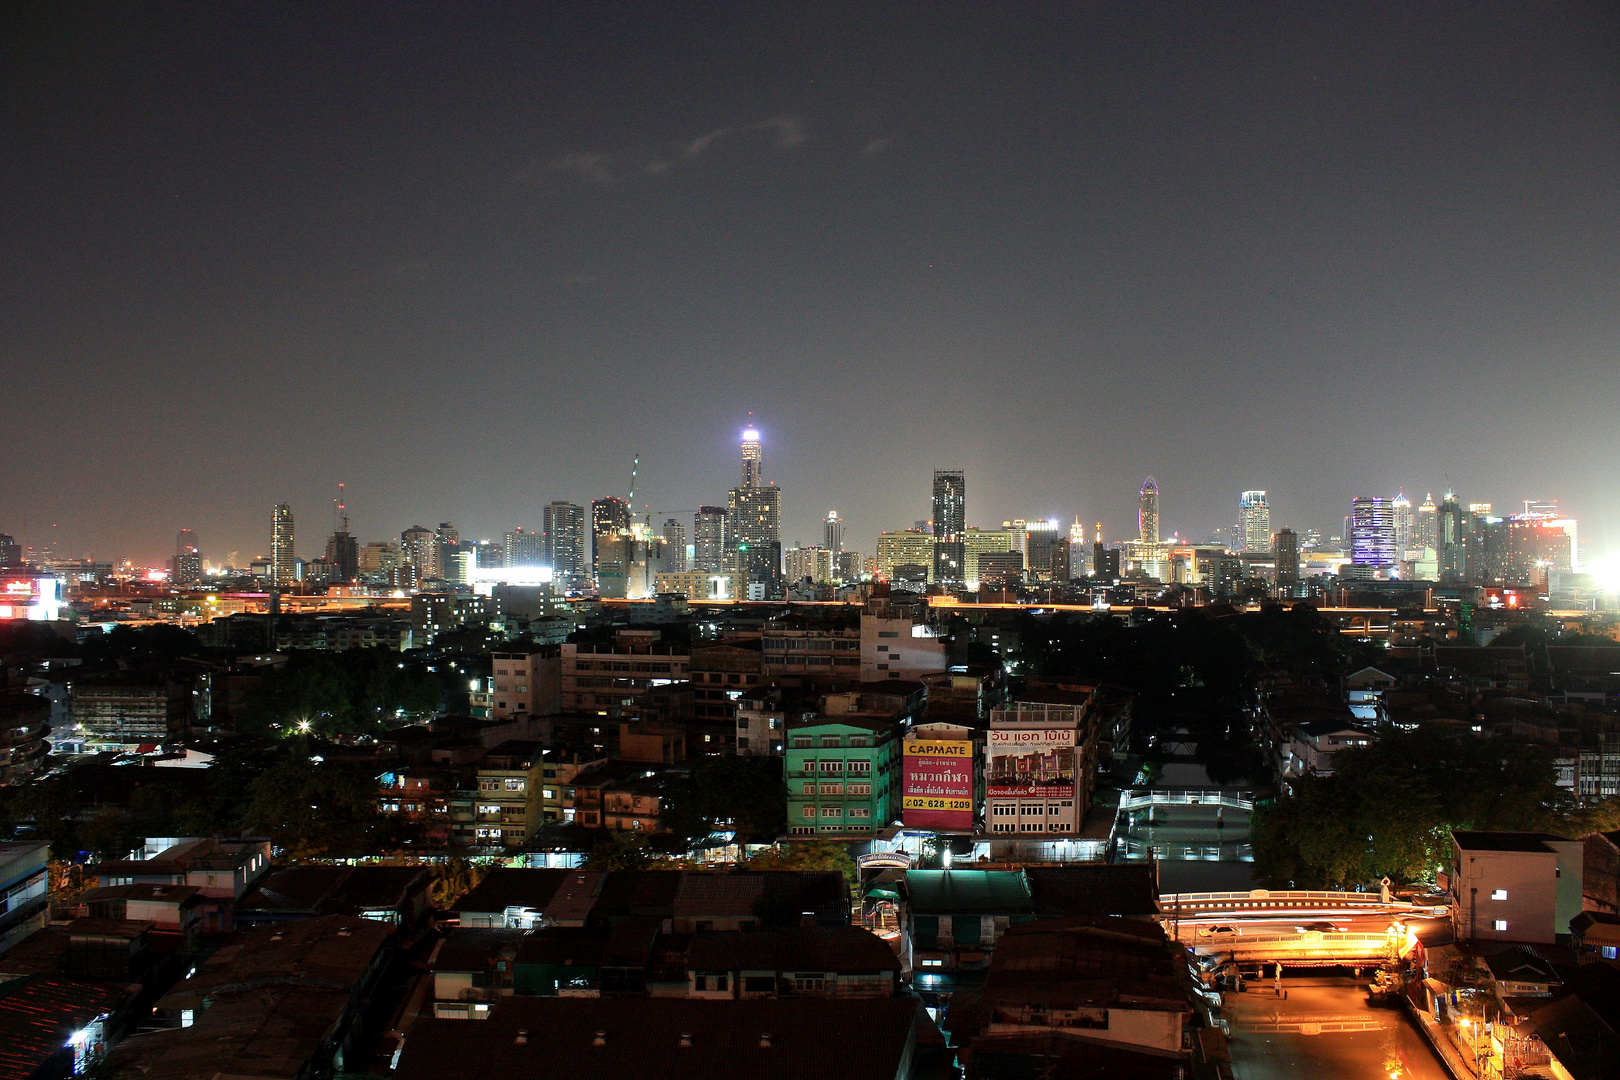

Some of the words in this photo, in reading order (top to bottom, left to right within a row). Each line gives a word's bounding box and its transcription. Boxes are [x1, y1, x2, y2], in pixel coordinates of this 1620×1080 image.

[992, 730, 1009, 741] วัน
[1014, 733, 1040, 741] แอท
[1044, 730, 1071, 741] โบ๊เบ๊
[909, 745, 966, 755] CAPMATE
[909, 769, 969, 783] หมวกกีฬา
[913, 799, 970, 809] 02-628-1209
